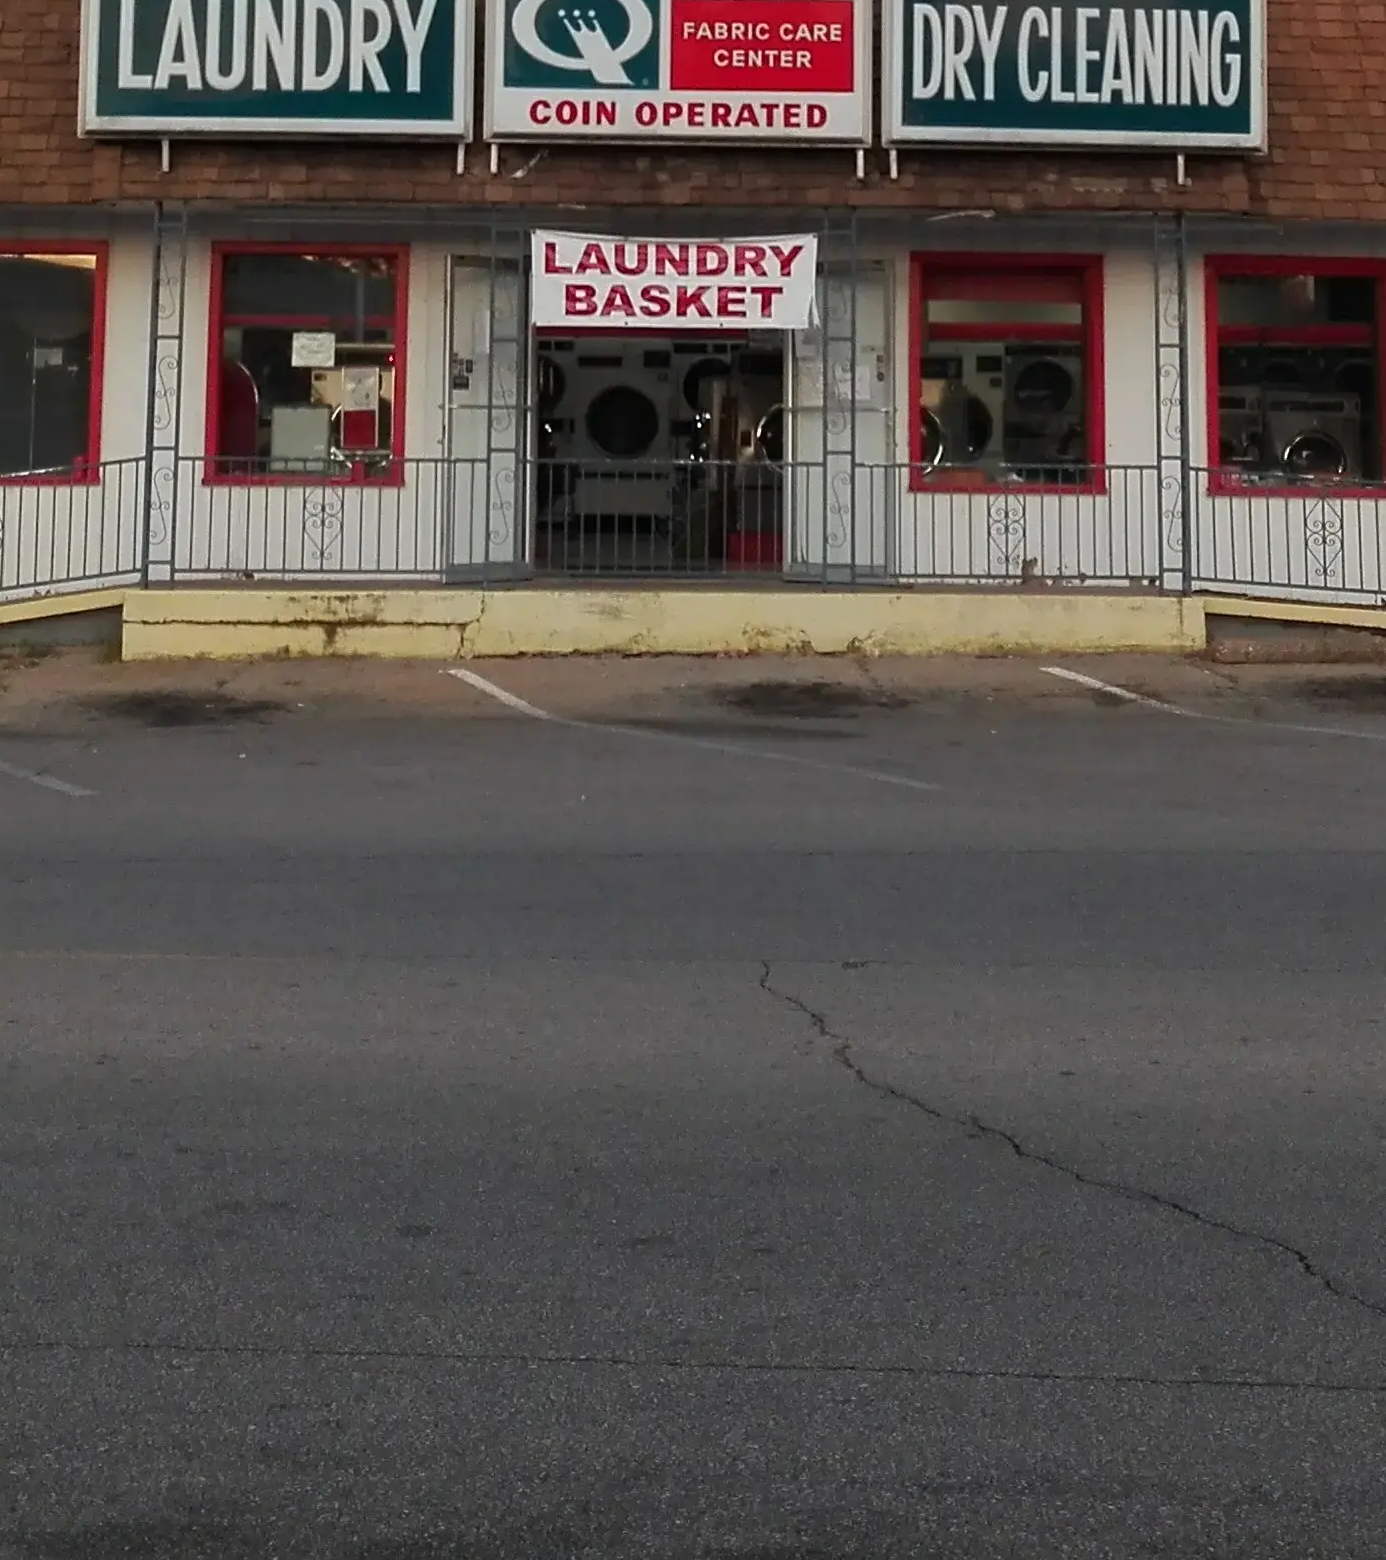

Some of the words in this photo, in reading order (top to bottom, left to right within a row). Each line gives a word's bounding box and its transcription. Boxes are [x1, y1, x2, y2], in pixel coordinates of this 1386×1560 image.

[683, 22, 770, 41] FABRIC
[779, 23, 842, 42] CARE
[713, 49, 812, 69] CENTER
[913, 3, 1007, 101] DRY
[1017, 5, 1242, 108] CLEANING
[529, 99, 617, 126] COIN
[635, 101, 828, 128] OPERATED
[543, 242, 804, 277] LAUNDRY
[563, 284, 784, 318] BASKET
